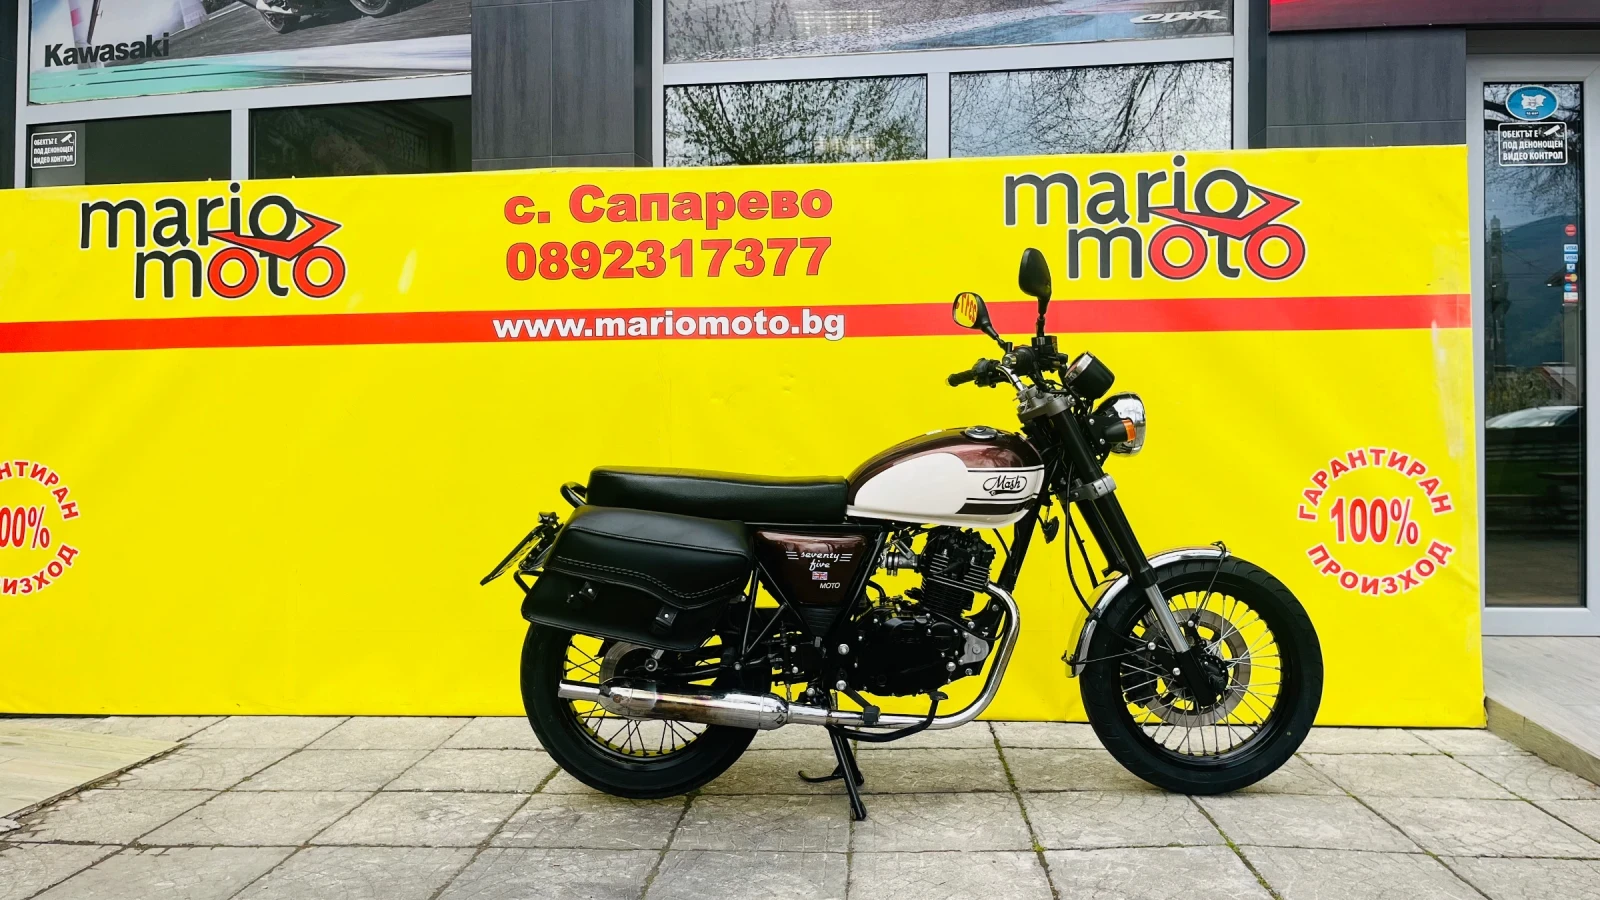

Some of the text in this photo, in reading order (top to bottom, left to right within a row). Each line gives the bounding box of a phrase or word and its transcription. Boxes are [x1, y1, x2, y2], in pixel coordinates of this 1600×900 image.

[44, 33, 170, 67] Kawasaki
[33, 146, 74, 155] ПОД ДЕНОНОЩЕН
[1502, 130, 1533, 138] ОБЕКТЪТ
[1502, 140, 1563, 149] ПОД ДЕНОНОЩЕН
[33, 155, 73, 165] ВИДЕО КОНТРОЛ
[1503, 151, 1563, 161] ВИДЕО КОНТРОЛ
[503, 184, 833, 230] с. Сапарево
[1005, 154, 1250, 225] mario
[80, 182, 297, 249] mario
[506, 236, 832, 281] 0892317377
[1068, 222, 1306, 281] moto
[134, 246, 347, 299] moto
[492, 307, 846, 342] www.mariomoto.bg
[1298, 448, 1452, 521] ГАРАНТИРАН
[1330, 498, 1419, 545] 100%
[800, 551, 840, 563] seventy
[809, 558, 831, 571] five
[1307, 541, 1453, 595] ПРОИЗХОД
